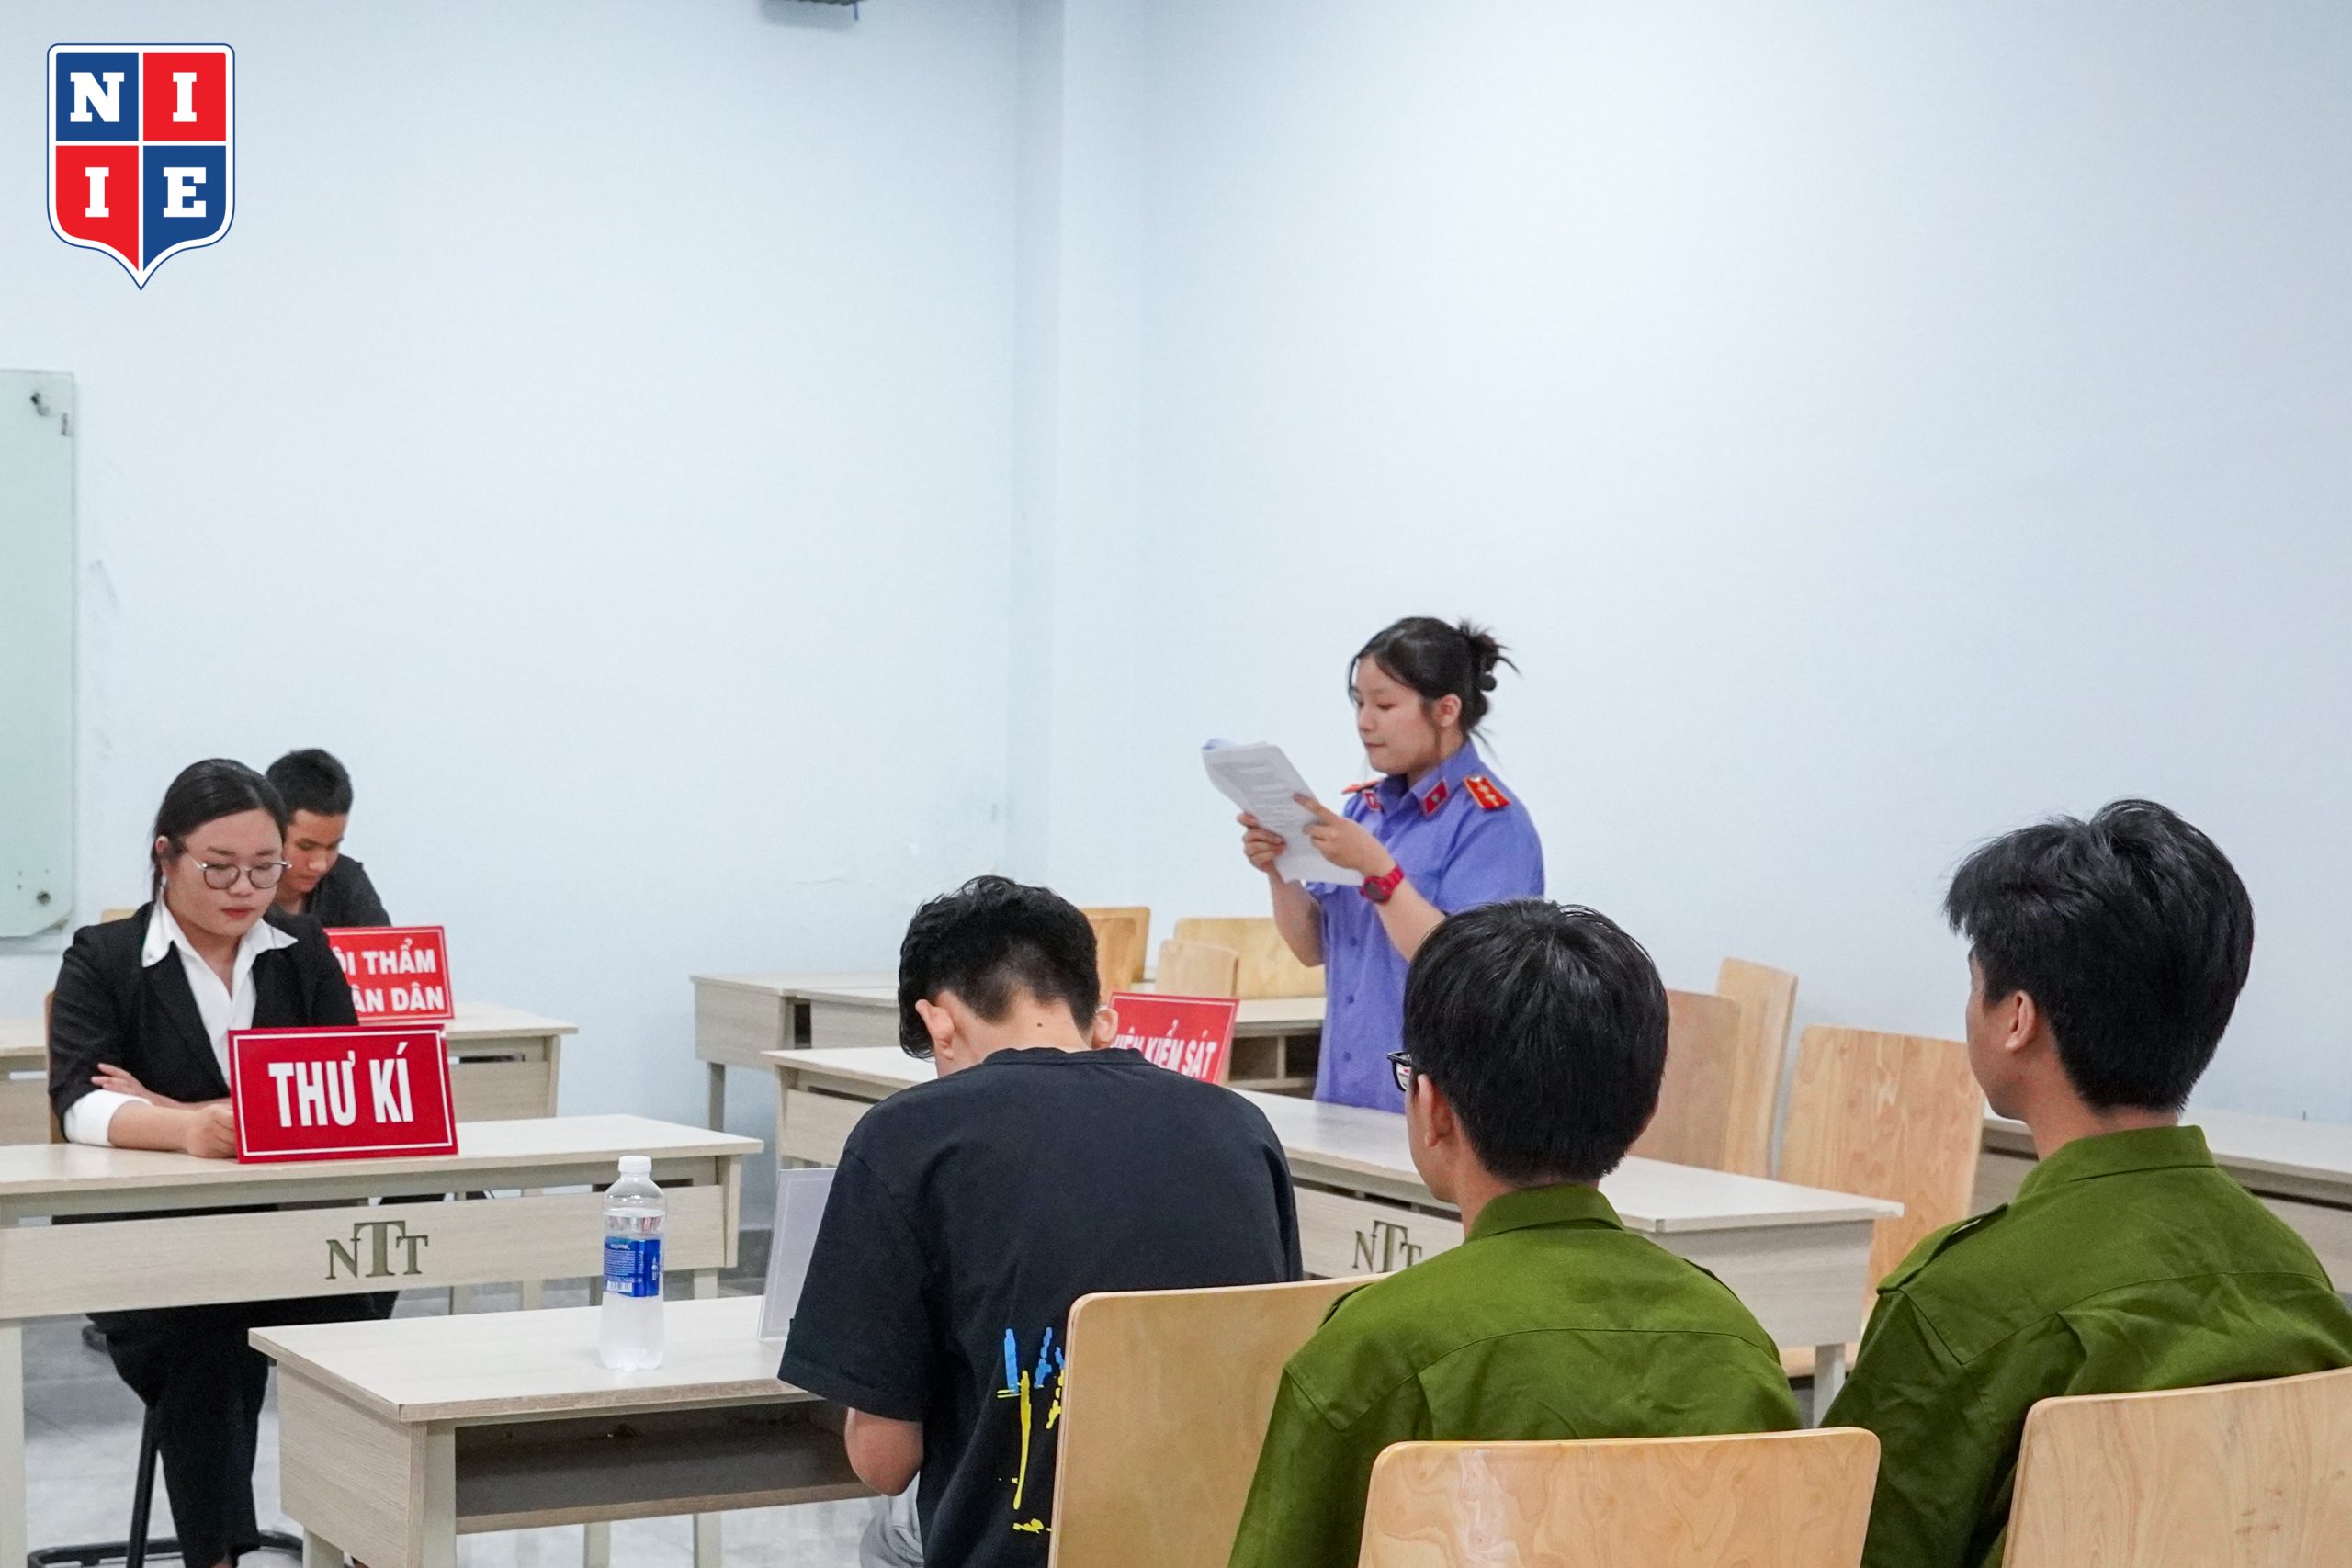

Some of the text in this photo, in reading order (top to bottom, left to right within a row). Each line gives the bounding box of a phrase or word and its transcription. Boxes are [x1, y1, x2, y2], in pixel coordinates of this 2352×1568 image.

[361, 937, 437, 976] THẨM
[351, 981, 445, 1013] ÂN DÂN
[1181, 1030, 1218, 1078] SÁT
[267, 1042, 414, 1128] THƯ KÍ
[325, 1220, 429, 1280] NTT
[1351, 1219, 1423, 1273] NTT
